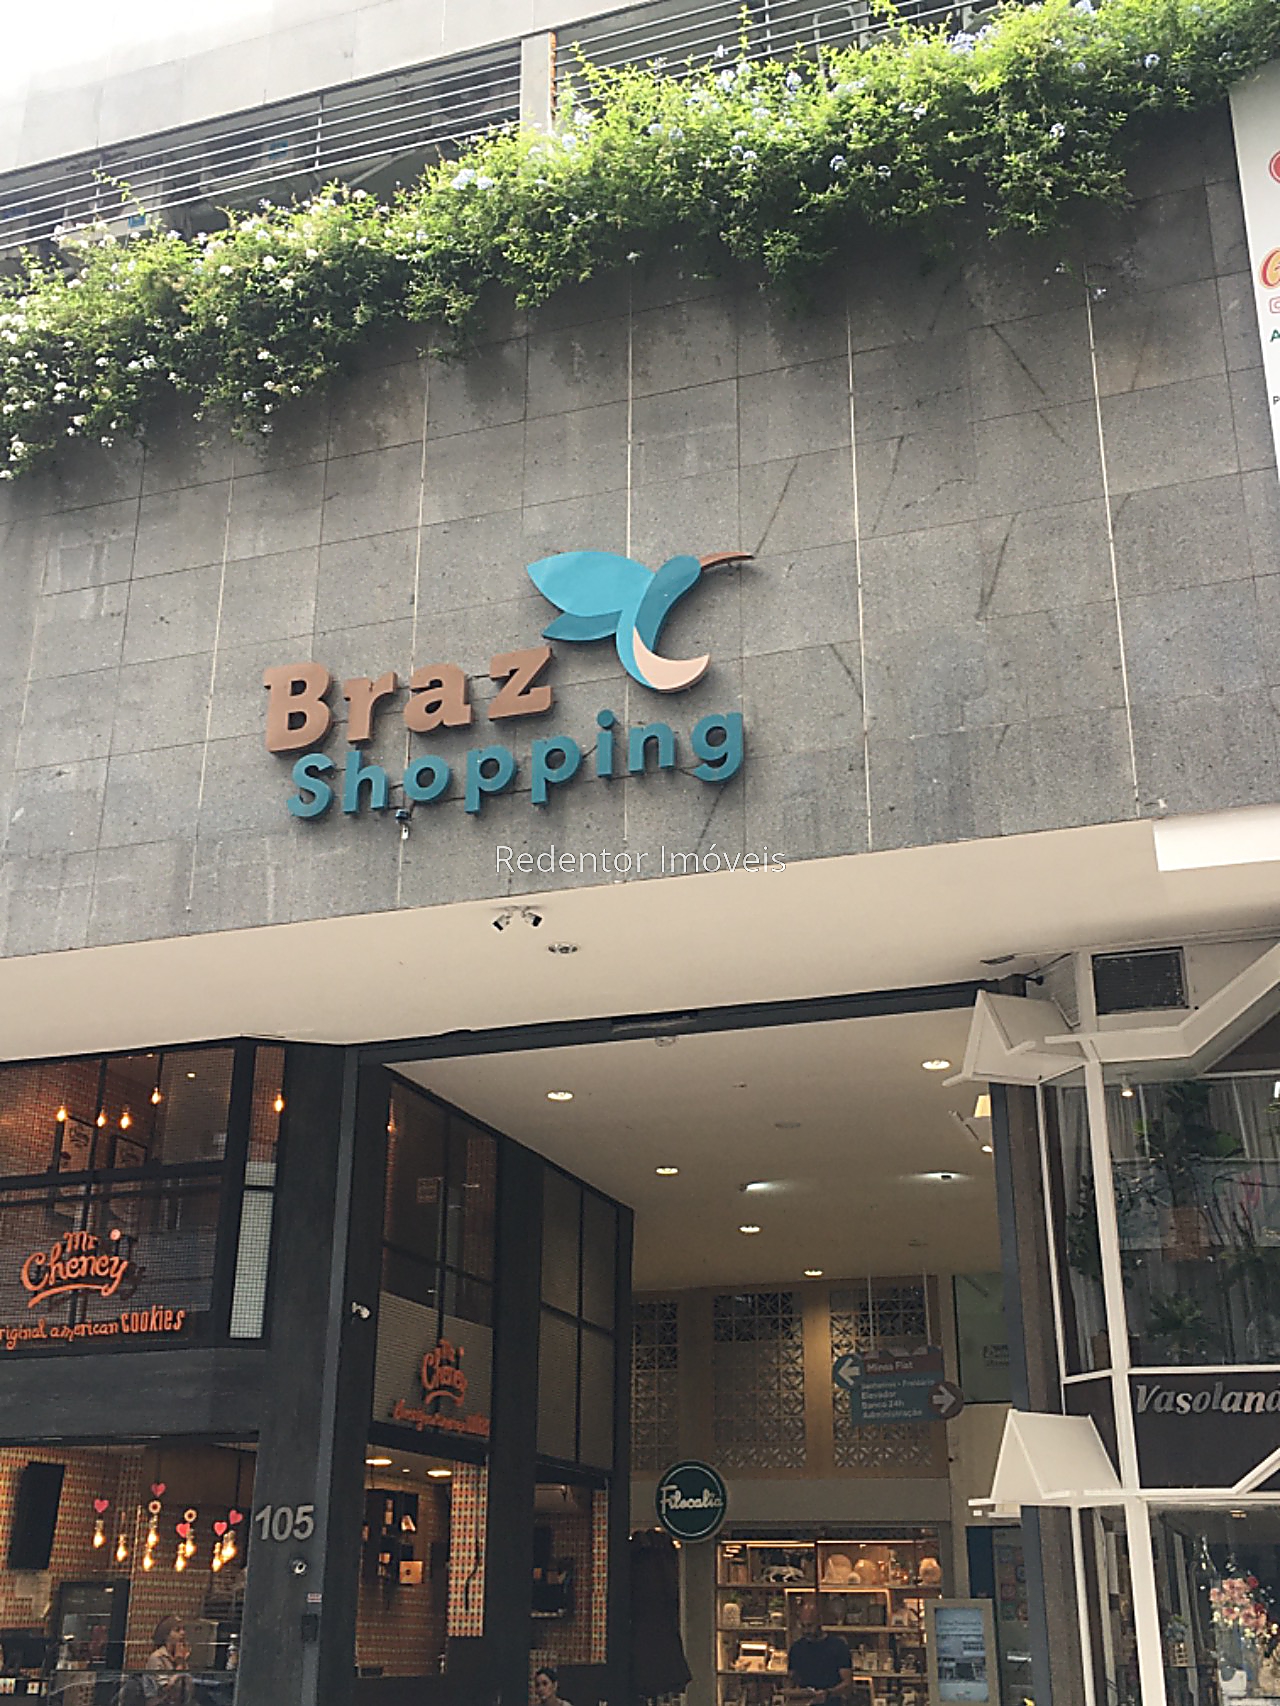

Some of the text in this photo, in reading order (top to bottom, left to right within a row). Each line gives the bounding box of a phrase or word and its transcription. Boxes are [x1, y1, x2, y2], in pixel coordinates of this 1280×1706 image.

[263, 646, 554, 753] Braz
[287, 709, 744, 819] Shopping
[21, 1243, 128, 1307] Cheney
[51, 1321, 119, 1342] american
[121, 1305, 186, 1333] cookies
[254, 1504, 315, 1542] 105
